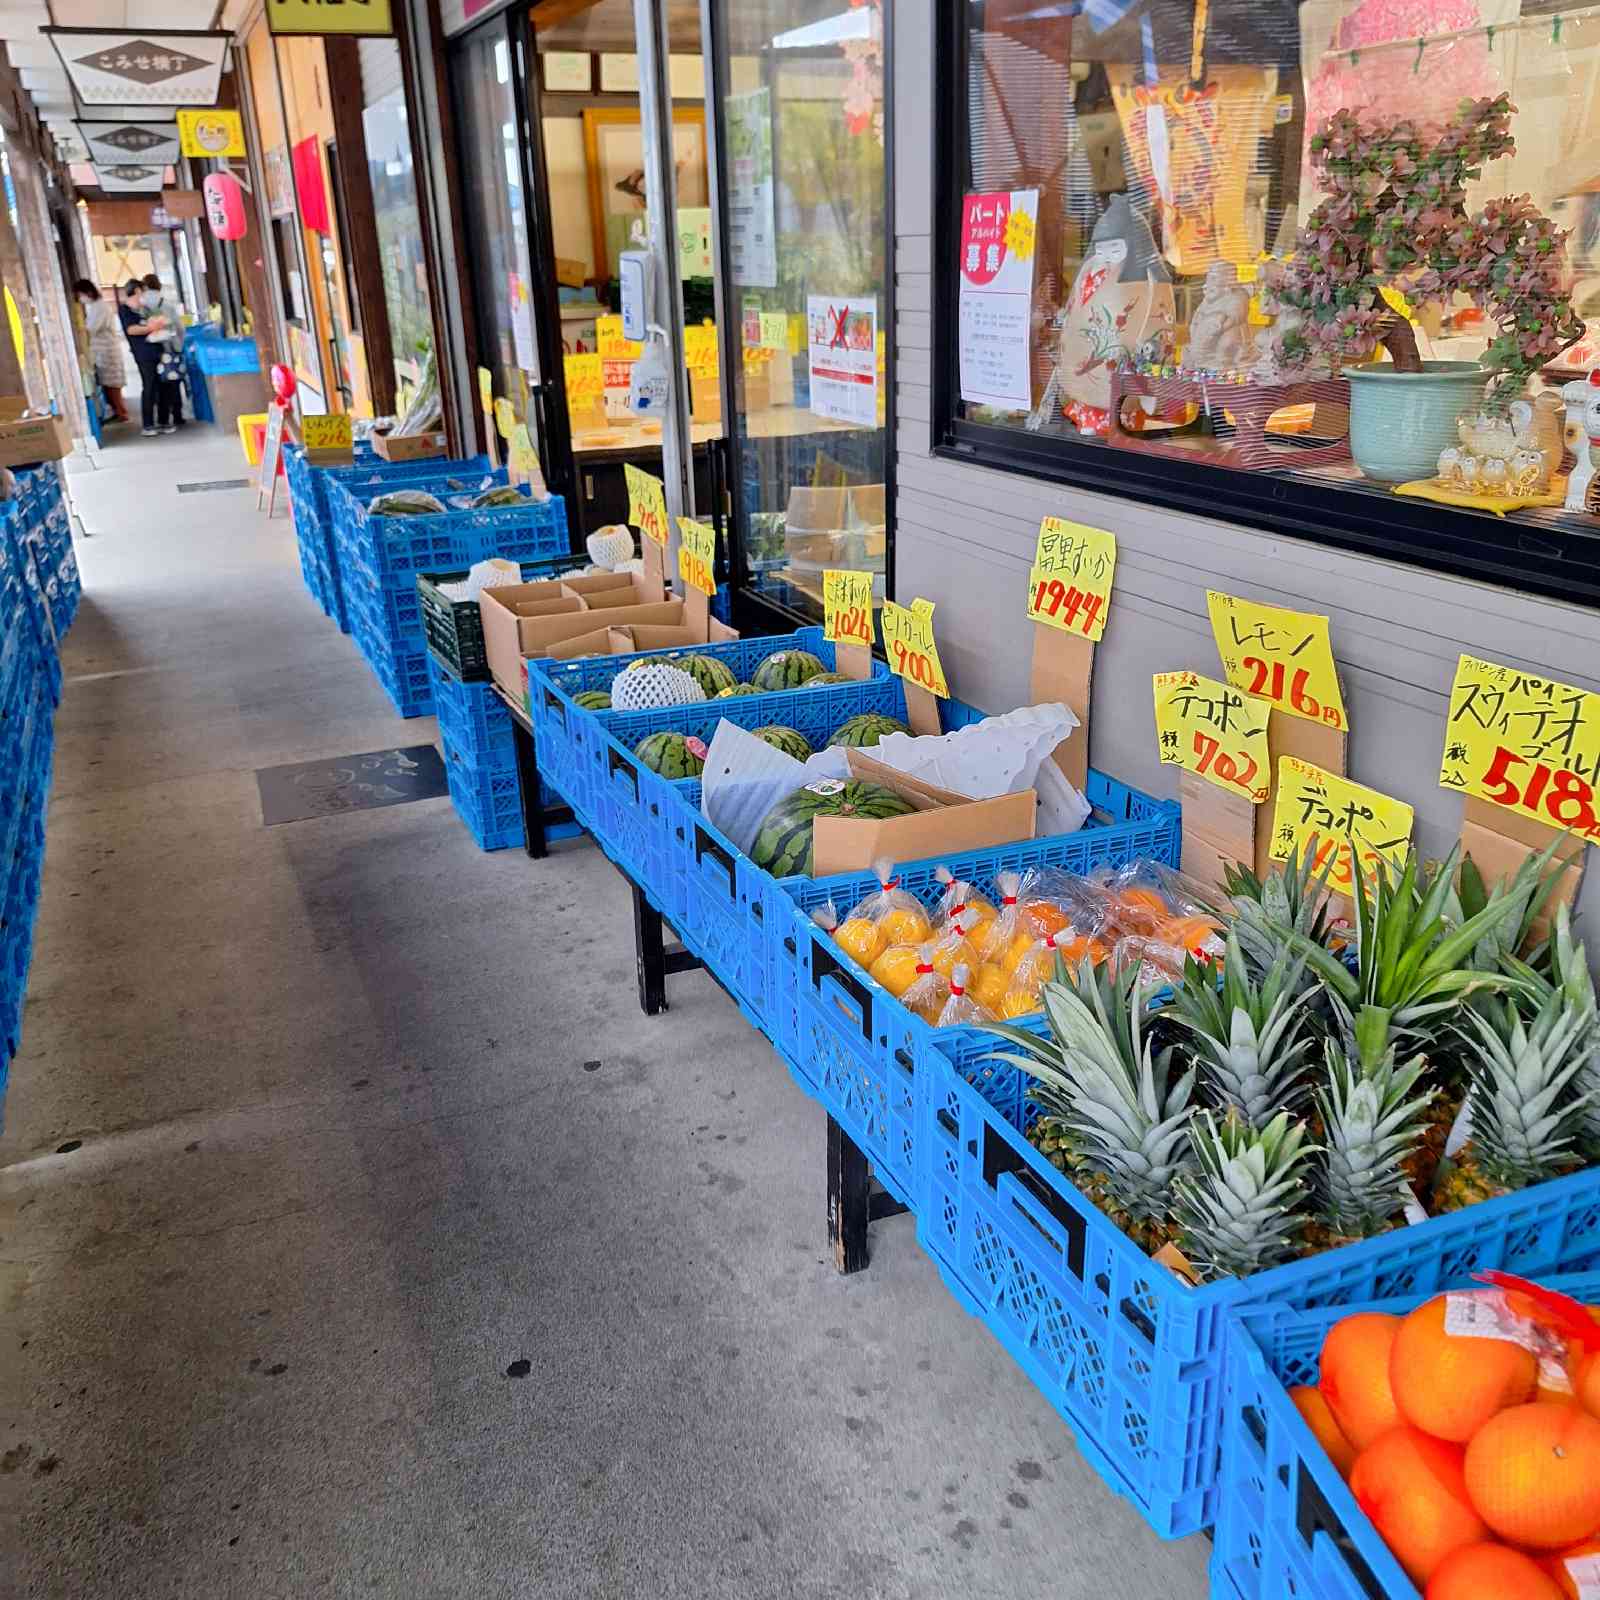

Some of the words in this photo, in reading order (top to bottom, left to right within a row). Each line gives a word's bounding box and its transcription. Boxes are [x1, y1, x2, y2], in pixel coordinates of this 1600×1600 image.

[99, 54, 188, 71] こみせ横丁
[970, 200, 1006, 224] パート
[966, 243, 1000, 272] 募集
[1230, 615, 1314, 656] レモン
[1509, 675, 1588, 703] パイン
[1295, 786, 1410, 850] デコポン
